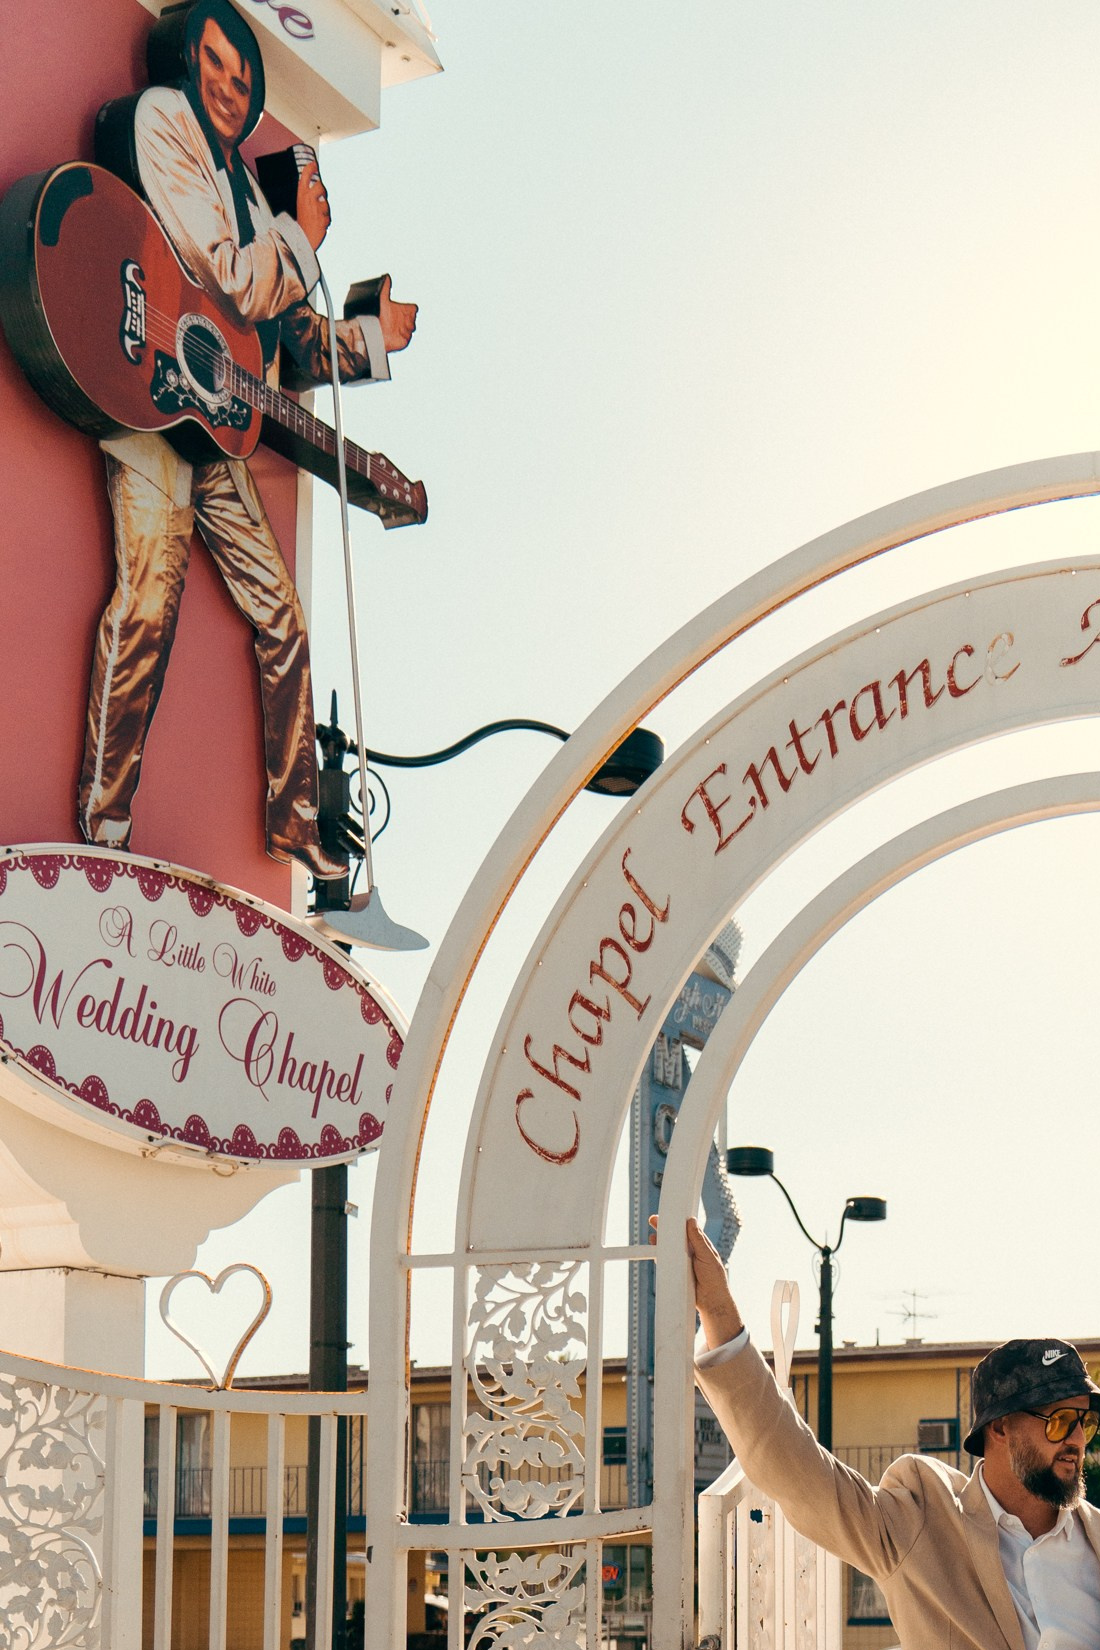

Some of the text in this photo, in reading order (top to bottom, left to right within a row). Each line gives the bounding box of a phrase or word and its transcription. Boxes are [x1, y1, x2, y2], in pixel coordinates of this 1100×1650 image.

[99, 905, 277, 997] A Little White
[514, 847, 671, 1166] Chapel
[680, 631, 1021, 857] Entrance
[0, 920, 364, 1119] Wedding Chapel
[1044, 1349, 1061, 1360] NIKE
